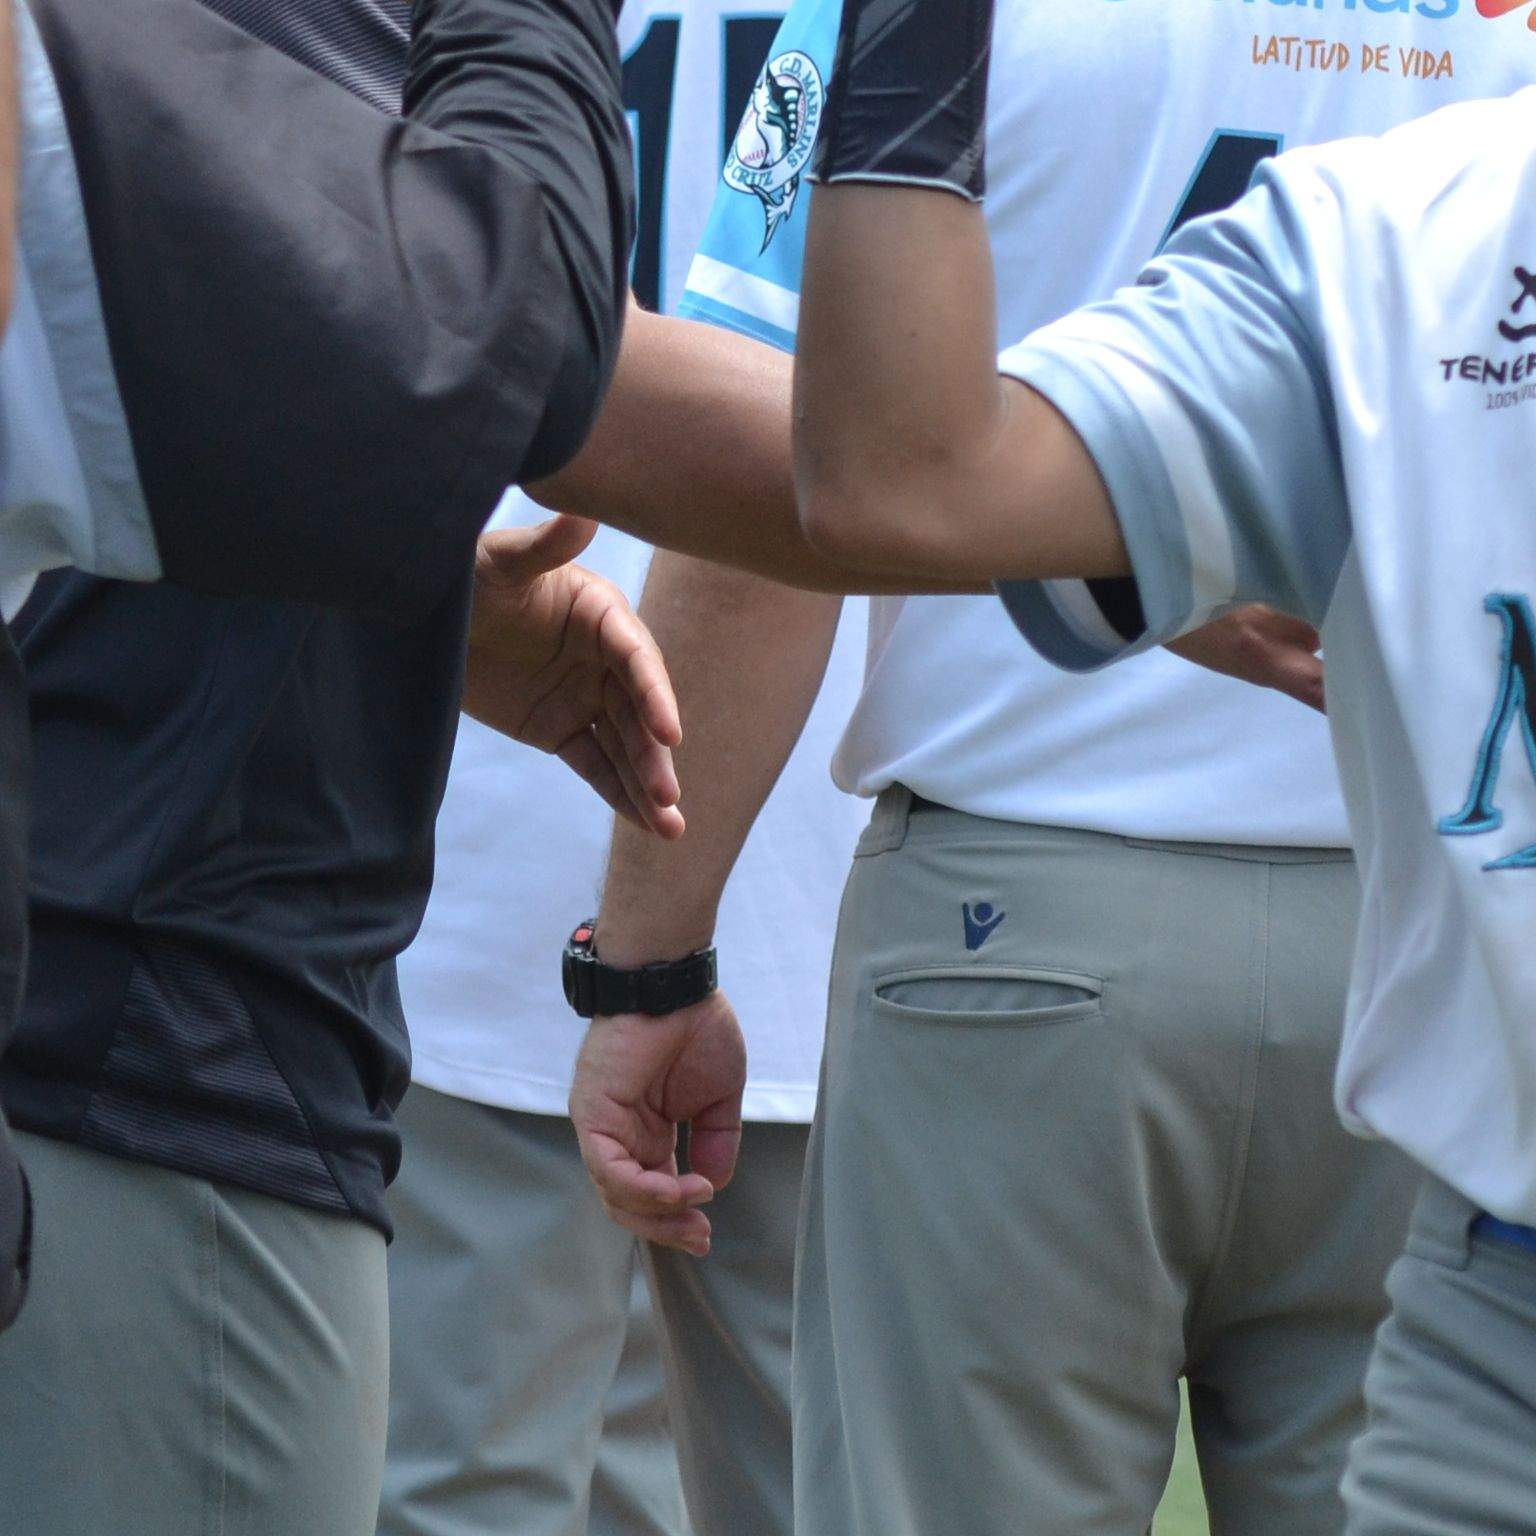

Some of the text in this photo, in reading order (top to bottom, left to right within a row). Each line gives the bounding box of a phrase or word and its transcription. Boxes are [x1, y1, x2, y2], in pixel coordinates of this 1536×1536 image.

[1252, 34, 1454, 80] LATITUD DE VIDA
